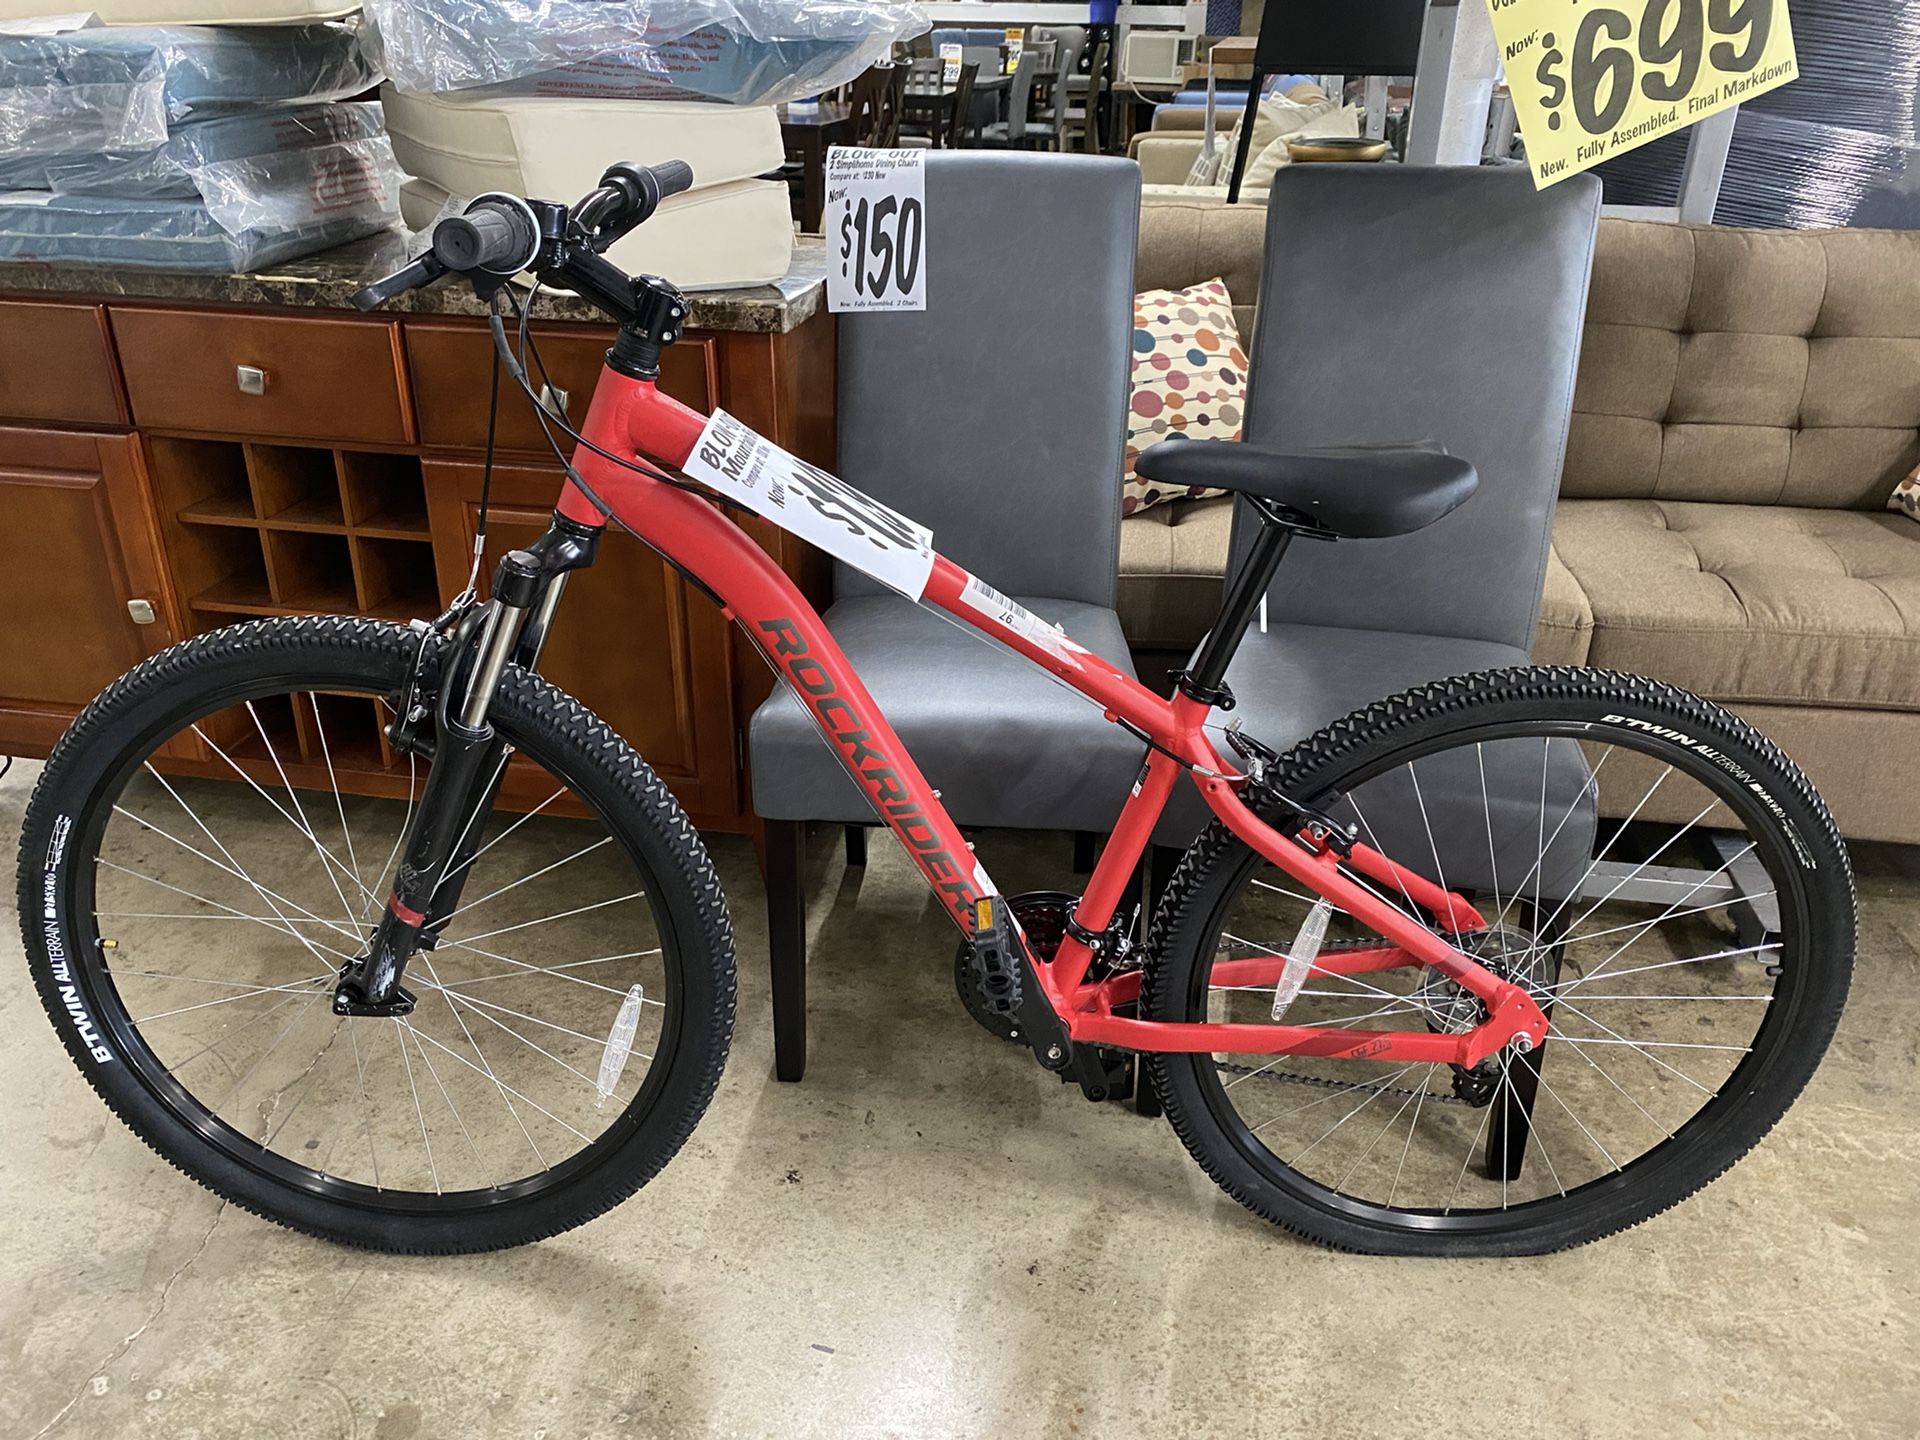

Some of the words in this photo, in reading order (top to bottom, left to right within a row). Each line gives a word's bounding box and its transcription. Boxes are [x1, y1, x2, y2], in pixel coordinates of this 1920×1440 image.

[1506, 29, 1539, 60] Now:
[1536, 0, 1773, 135] $699
[1540, 156, 1569, 178] New.
[1576, 137, 1607, 163] Fully
[1610, 106, 1680, 147] Assembled.
[1688, 88, 1719, 115] Final
[1723, 59, 1793, 100] Markdown
[829, 160, 835, 170] 2
[876, 159, 896, 169] Dining
[898, 159, 919, 168] Chairs
[831, 149, 924, 160] BLOW-OUT
[829, 172, 853, 181] Compare
[828, 186, 848, 203] Now:
[840, 194, 922, 299] $150
[767, 477, 785, 510] Now:
[758, 617, 980, 914] ROCKRIDER
